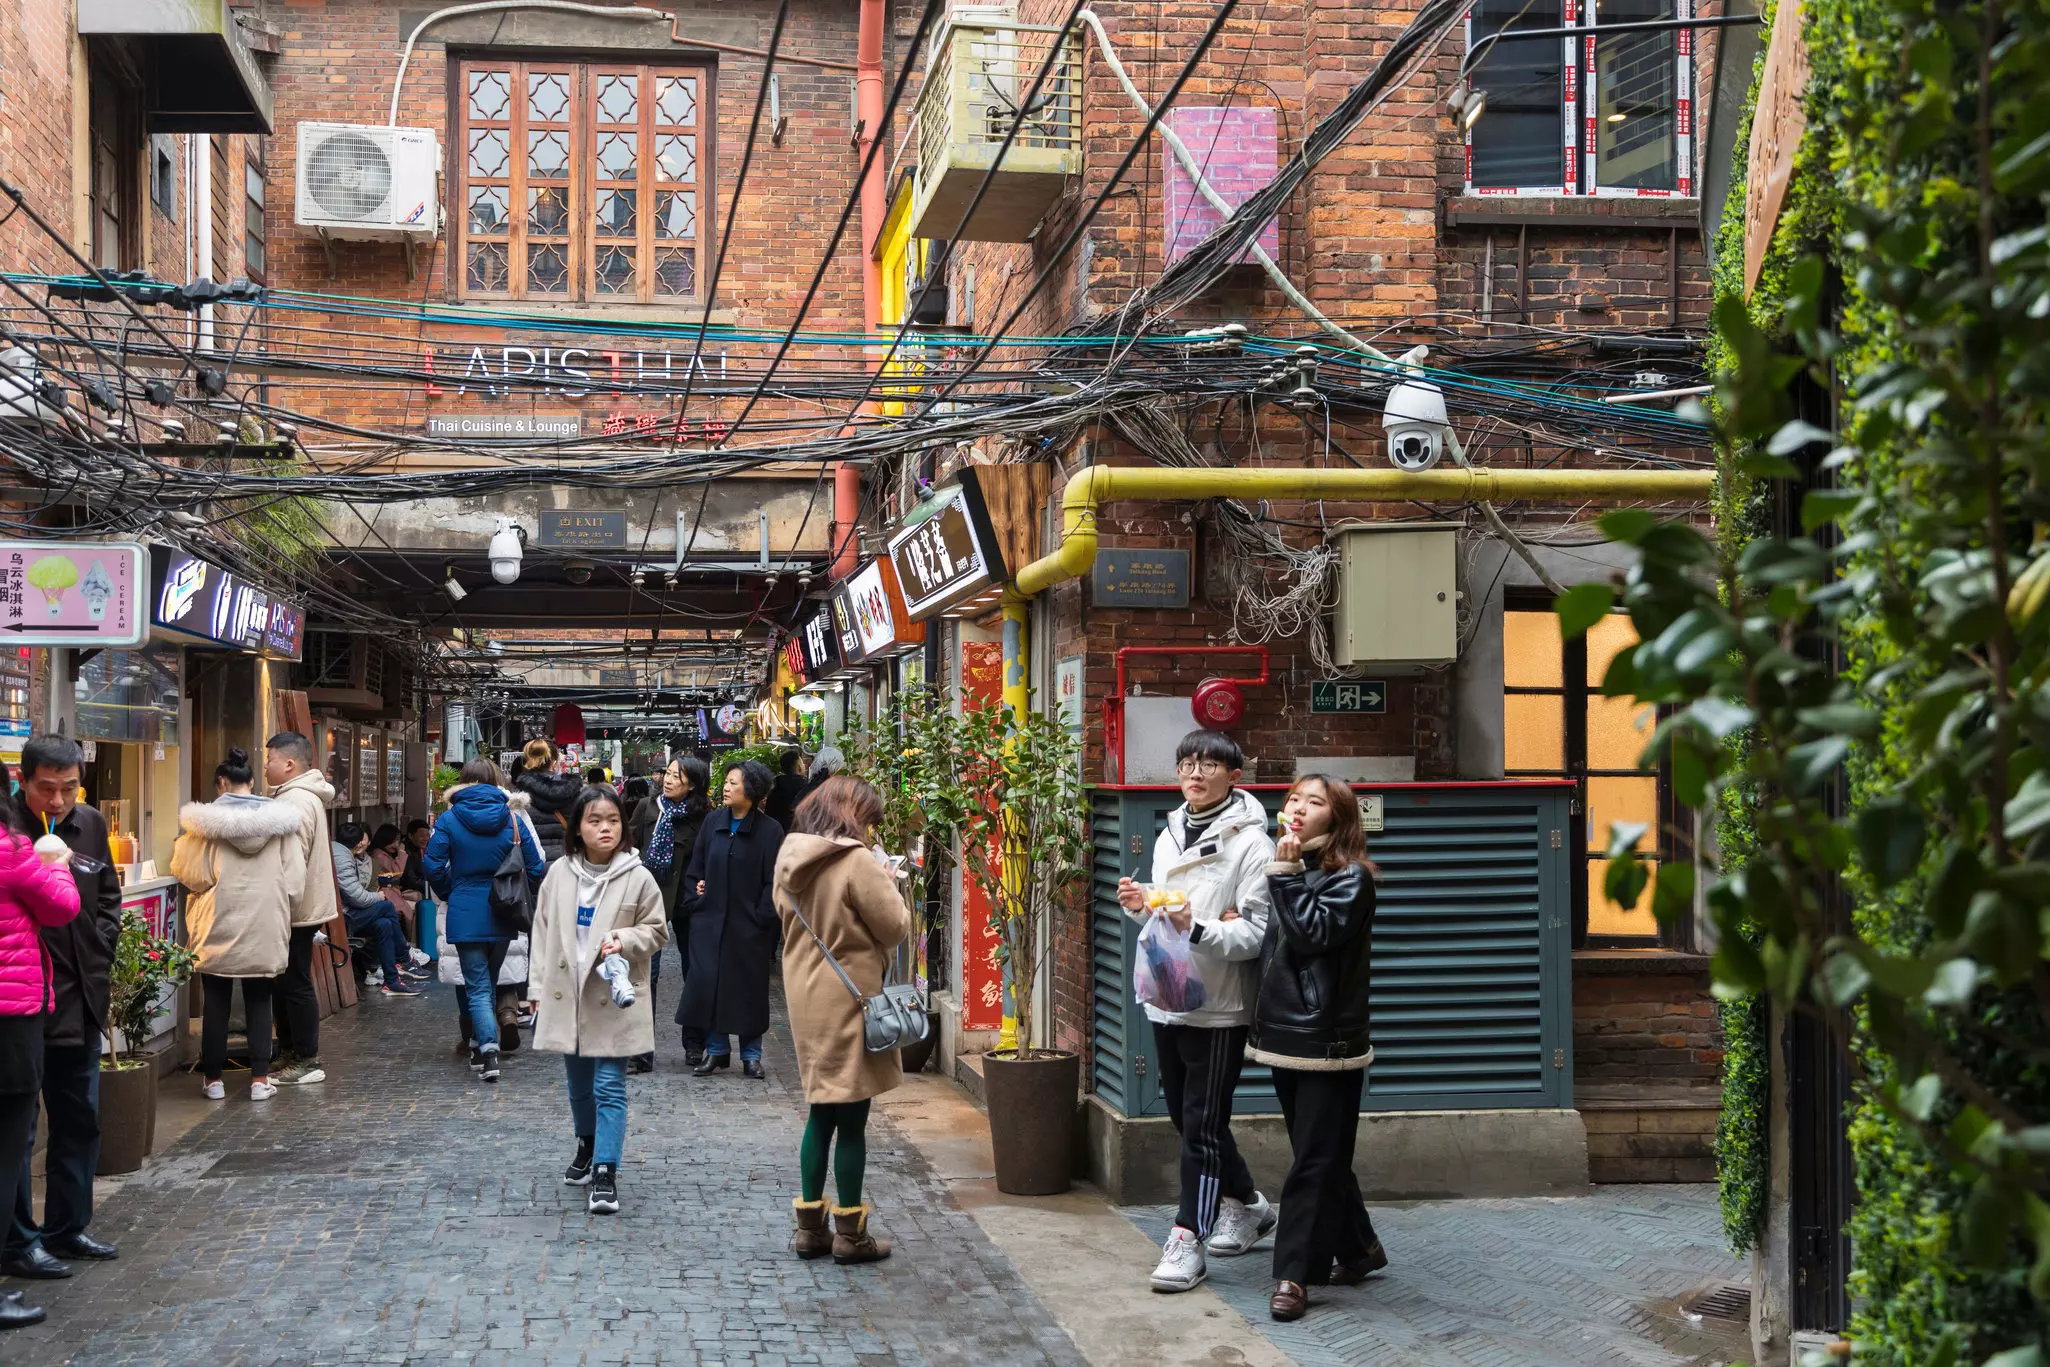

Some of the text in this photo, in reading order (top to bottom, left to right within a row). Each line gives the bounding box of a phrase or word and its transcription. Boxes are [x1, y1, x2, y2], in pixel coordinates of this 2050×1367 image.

[429, 419, 578, 435] Thai Cuisine & Lounge
[576, 517, 605, 527] EXIT
[9, 552, 24, 618] 乌云冰淇淋
[118, 585, 126, 629] CEREAM
